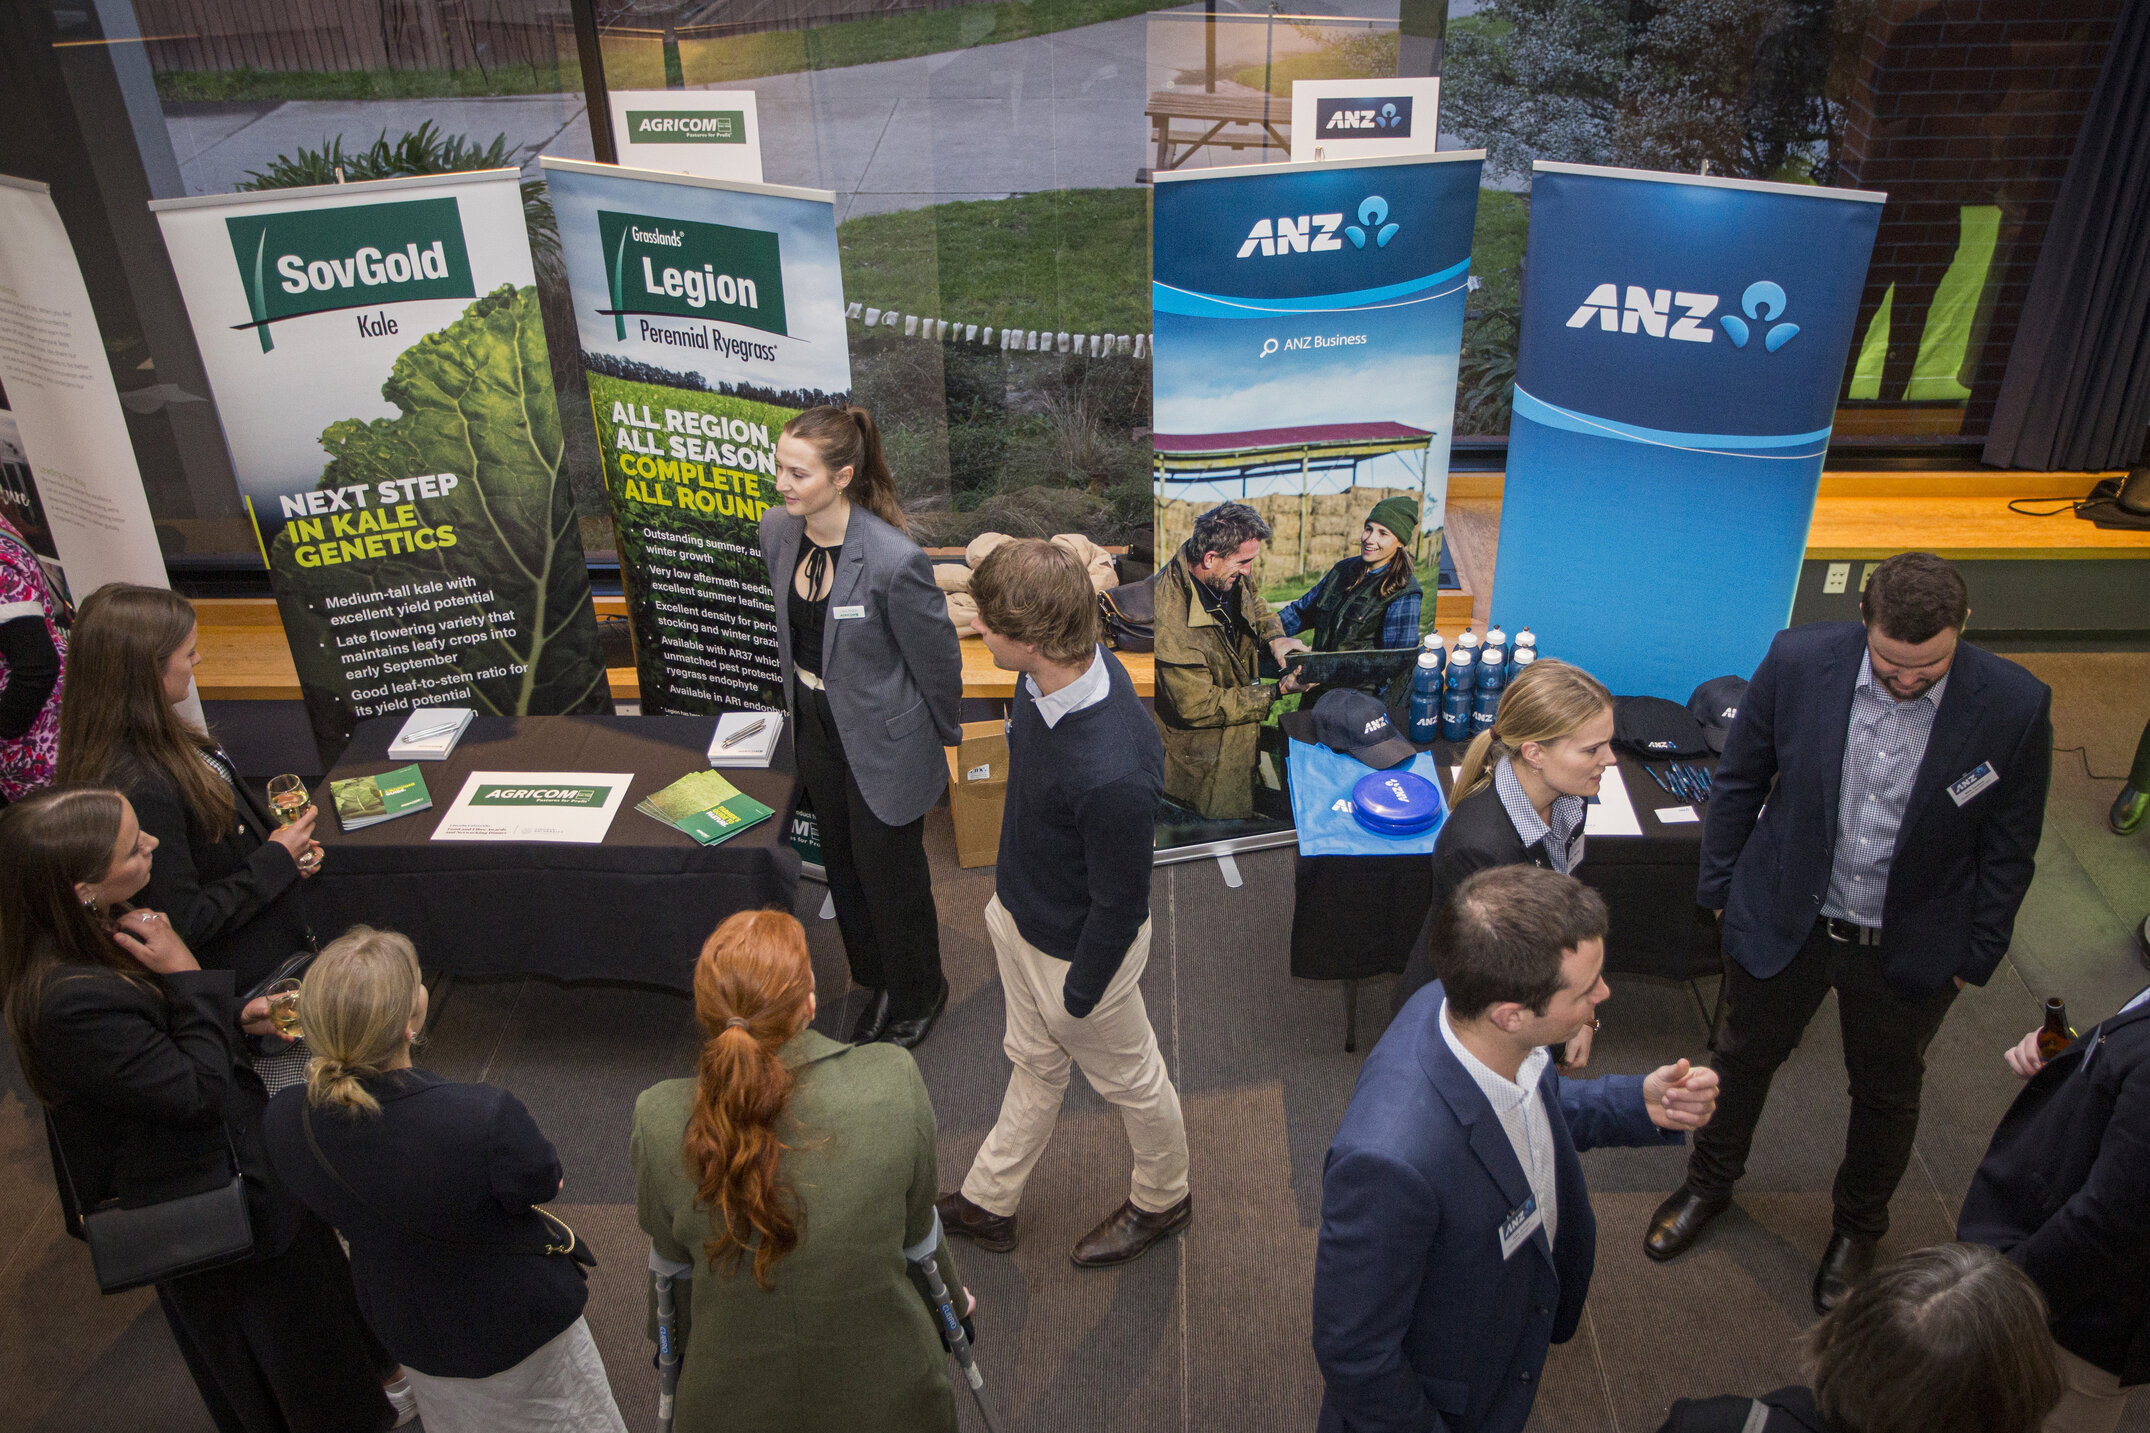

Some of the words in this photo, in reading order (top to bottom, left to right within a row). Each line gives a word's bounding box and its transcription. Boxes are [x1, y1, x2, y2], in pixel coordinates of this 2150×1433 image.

[638, 118, 716, 132] AGRICOM
[1326, 110, 1376, 130] ANZ
[1236, 213, 1342, 258] ANZ
[277, 241, 448, 294] SovGold
[642, 256, 758, 309] Legion
[356, 311, 398, 338] Kale
[1566, 283, 1719, 343] ANZ
[640, 319, 709, 350] Perennial
[1284, 336, 1312, 351] ANZ
[1314, 333, 1367, 348] Business
[612, 401, 660, 430] ALL
[664, 408, 776, 454] REGION,
[616, 427, 665, 456] ALL
[668, 435, 776, 476] SEASON
[620, 453, 760, 498] COMPLETE
[280, 484, 370, 518] NEXT
[378, 472, 458, 504] STEP
[625, 479, 672, 507] ALL
[286, 518, 326, 544] IN
[331, 504, 418, 538] KALE
[294, 525, 458, 568] GENETICS
[643, 528, 704, 548] Outstanding
[706, 540, 748, 556] summer,
[646, 545, 677, 557] winter
[680, 551, 714, 564] growth
[649, 564, 671, 578] Very
[673, 568, 691, 579] low
[693, 572, 740, 588] aftermath
[326, 584, 410, 609] Medium-tall
[414, 581, 443, 594] kale
[446, 576, 477, 590] with
[652, 582, 696, 596] excellent
[697, 589, 736, 603] summer
[330, 606, 394, 625] excellent
[396, 600, 430, 618] yield
[434, 590, 494, 612] potential
[656, 600, 700, 616] Excellent
[701, 609, 736, 625] density
[738, 616, 751, 626] for
[336, 634, 368, 647] Late
[370, 623, 436, 641] flowering
[438, 615, 485, 630] variety
[488, 610, 515, 623] that
[658, 617, 699, 633] stocking
[701, 624, 719, 634] and
[721, 629, 750, 641] winter
[341, 645, 410, 664] maintains
[412, 638, 446, 651] leafy
[449, 632, 488, 645] crops
[490, 628, 517, 639] into
[662, 636, 704, 651] Available
[706, 645, 726, 655] with
[729, 648, 752, 661] AR37
[346, 666, 380, 680] early
[383, 653, 458, 673] September
[664, 652, 717, 668] unmatched
[719, 662, 740, 673] pest
[351, 684, 389, 700] Good
[391, 672, 473, 693] leaf-to-stem
[477, 667, 507, 680] ratio
[509, 664, 528, 675] for
[666, 667, 707, 680] ryegrass
[709, 674, 759, 692] endophyte
[355, 705, 373, 716] its
[375, 697, 408, 715] yield
[412, 687, 471, 708] potential
[670, 684, 712, 700] Available
[714, 692, 723, 702] in
[725, 695, 741, 706] AR1
[1364, 716, 1385, 734] ANZ
[1416, 715, 1438, 726] ANZ
[485, 789, 578, 799] AGRICOM
[1392, 785, 1410, 803] ANZ
[1956, 774, 1977, 793] ANZ
[1506, 1210, 1525, 1238] ANZ
